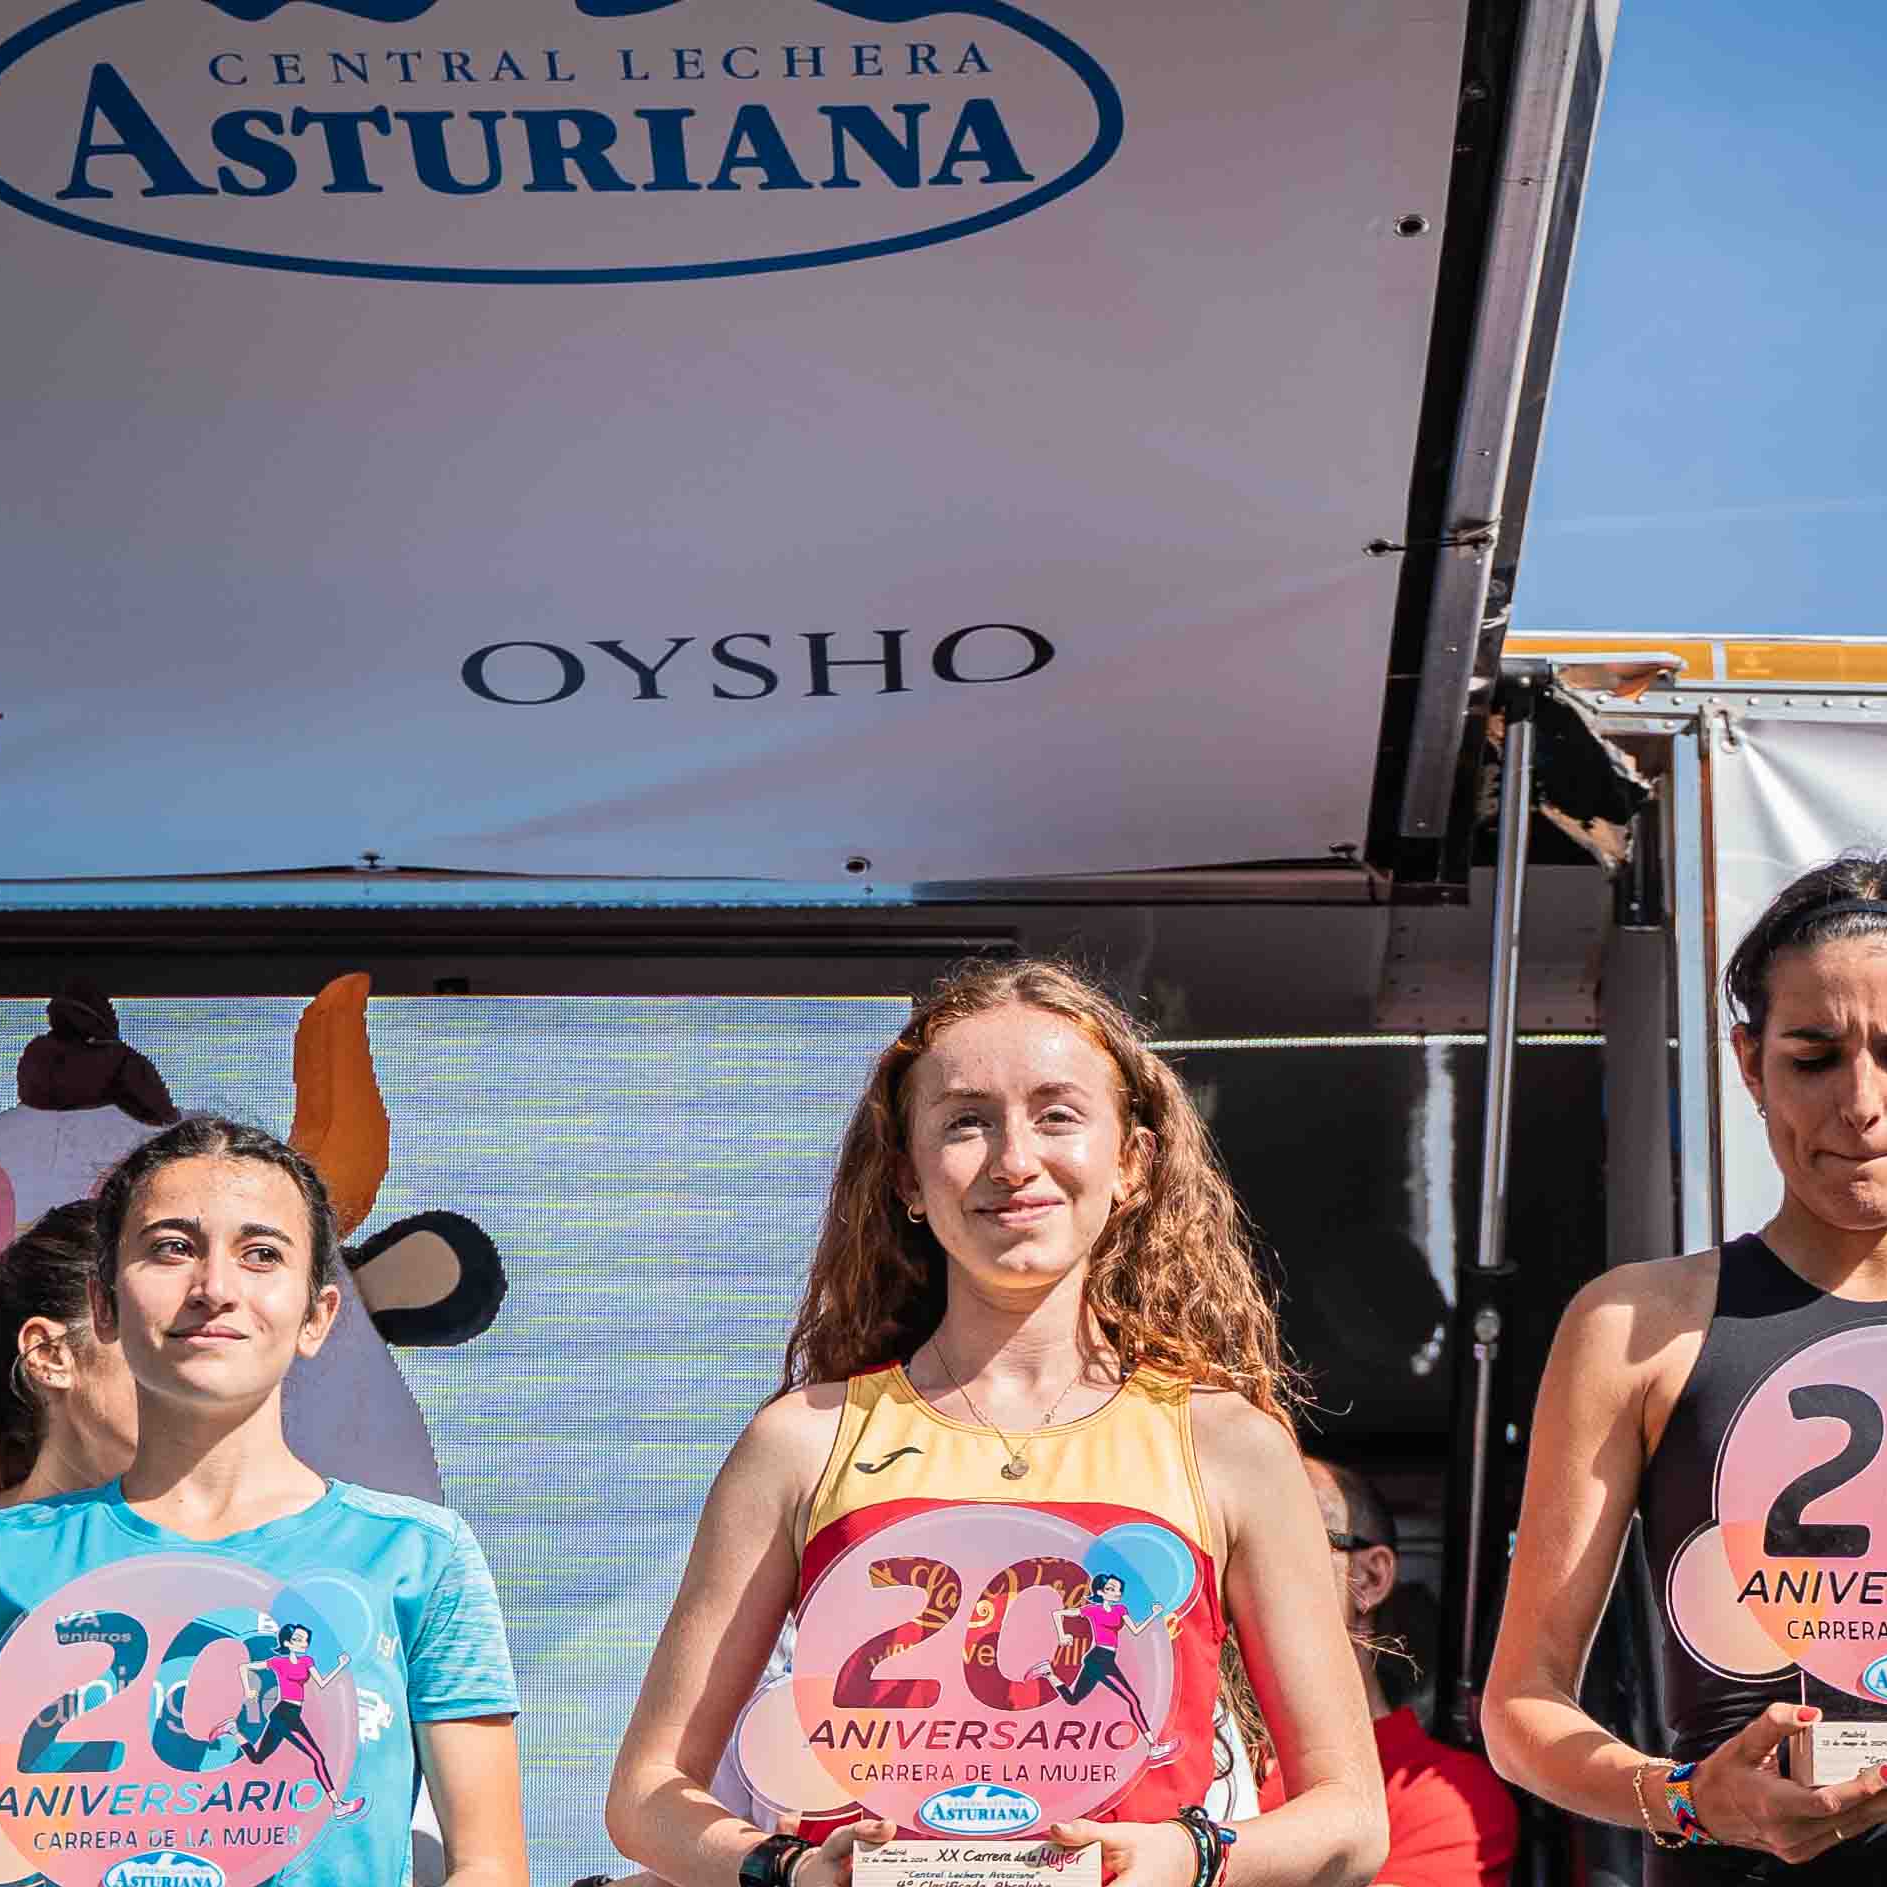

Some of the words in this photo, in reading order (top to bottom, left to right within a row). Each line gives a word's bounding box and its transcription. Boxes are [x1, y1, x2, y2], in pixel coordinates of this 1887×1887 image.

[210, 49, 577, 86] CENTRAL
[621, 41, 992, 82] LECHERA
[55, 63, 1035, 200] ASTURIANA
[460, 622, 1057, 707] OYSHO
[832, 1555, 1094, 1712] 20
[18, 1608, 279, 1774] 20
[808, 1719, 1140, 1751] ANIVERSARIO
[850, 1763, 954, 1782] CARRERA
[965, 1763, 993, 1782] DE
[1003, 1764, 1030, 1782] LA
[1040, 1763, 1117, 1783] MUJER
[931, 1802, 1030, 1821] ASTURIANA
[34, 1830, 138, 1850] CARRERA
[148, 1829, 177, 1848] DE
[186, 1828, 212, 1847] LA
[224, 1824, 301, 1845] MUJER
[936, 1849, 960, 1862] XX
[963, 1849, 1011, 1862] Carrera
[1038, 1847, 1086, 1872] Mujer
